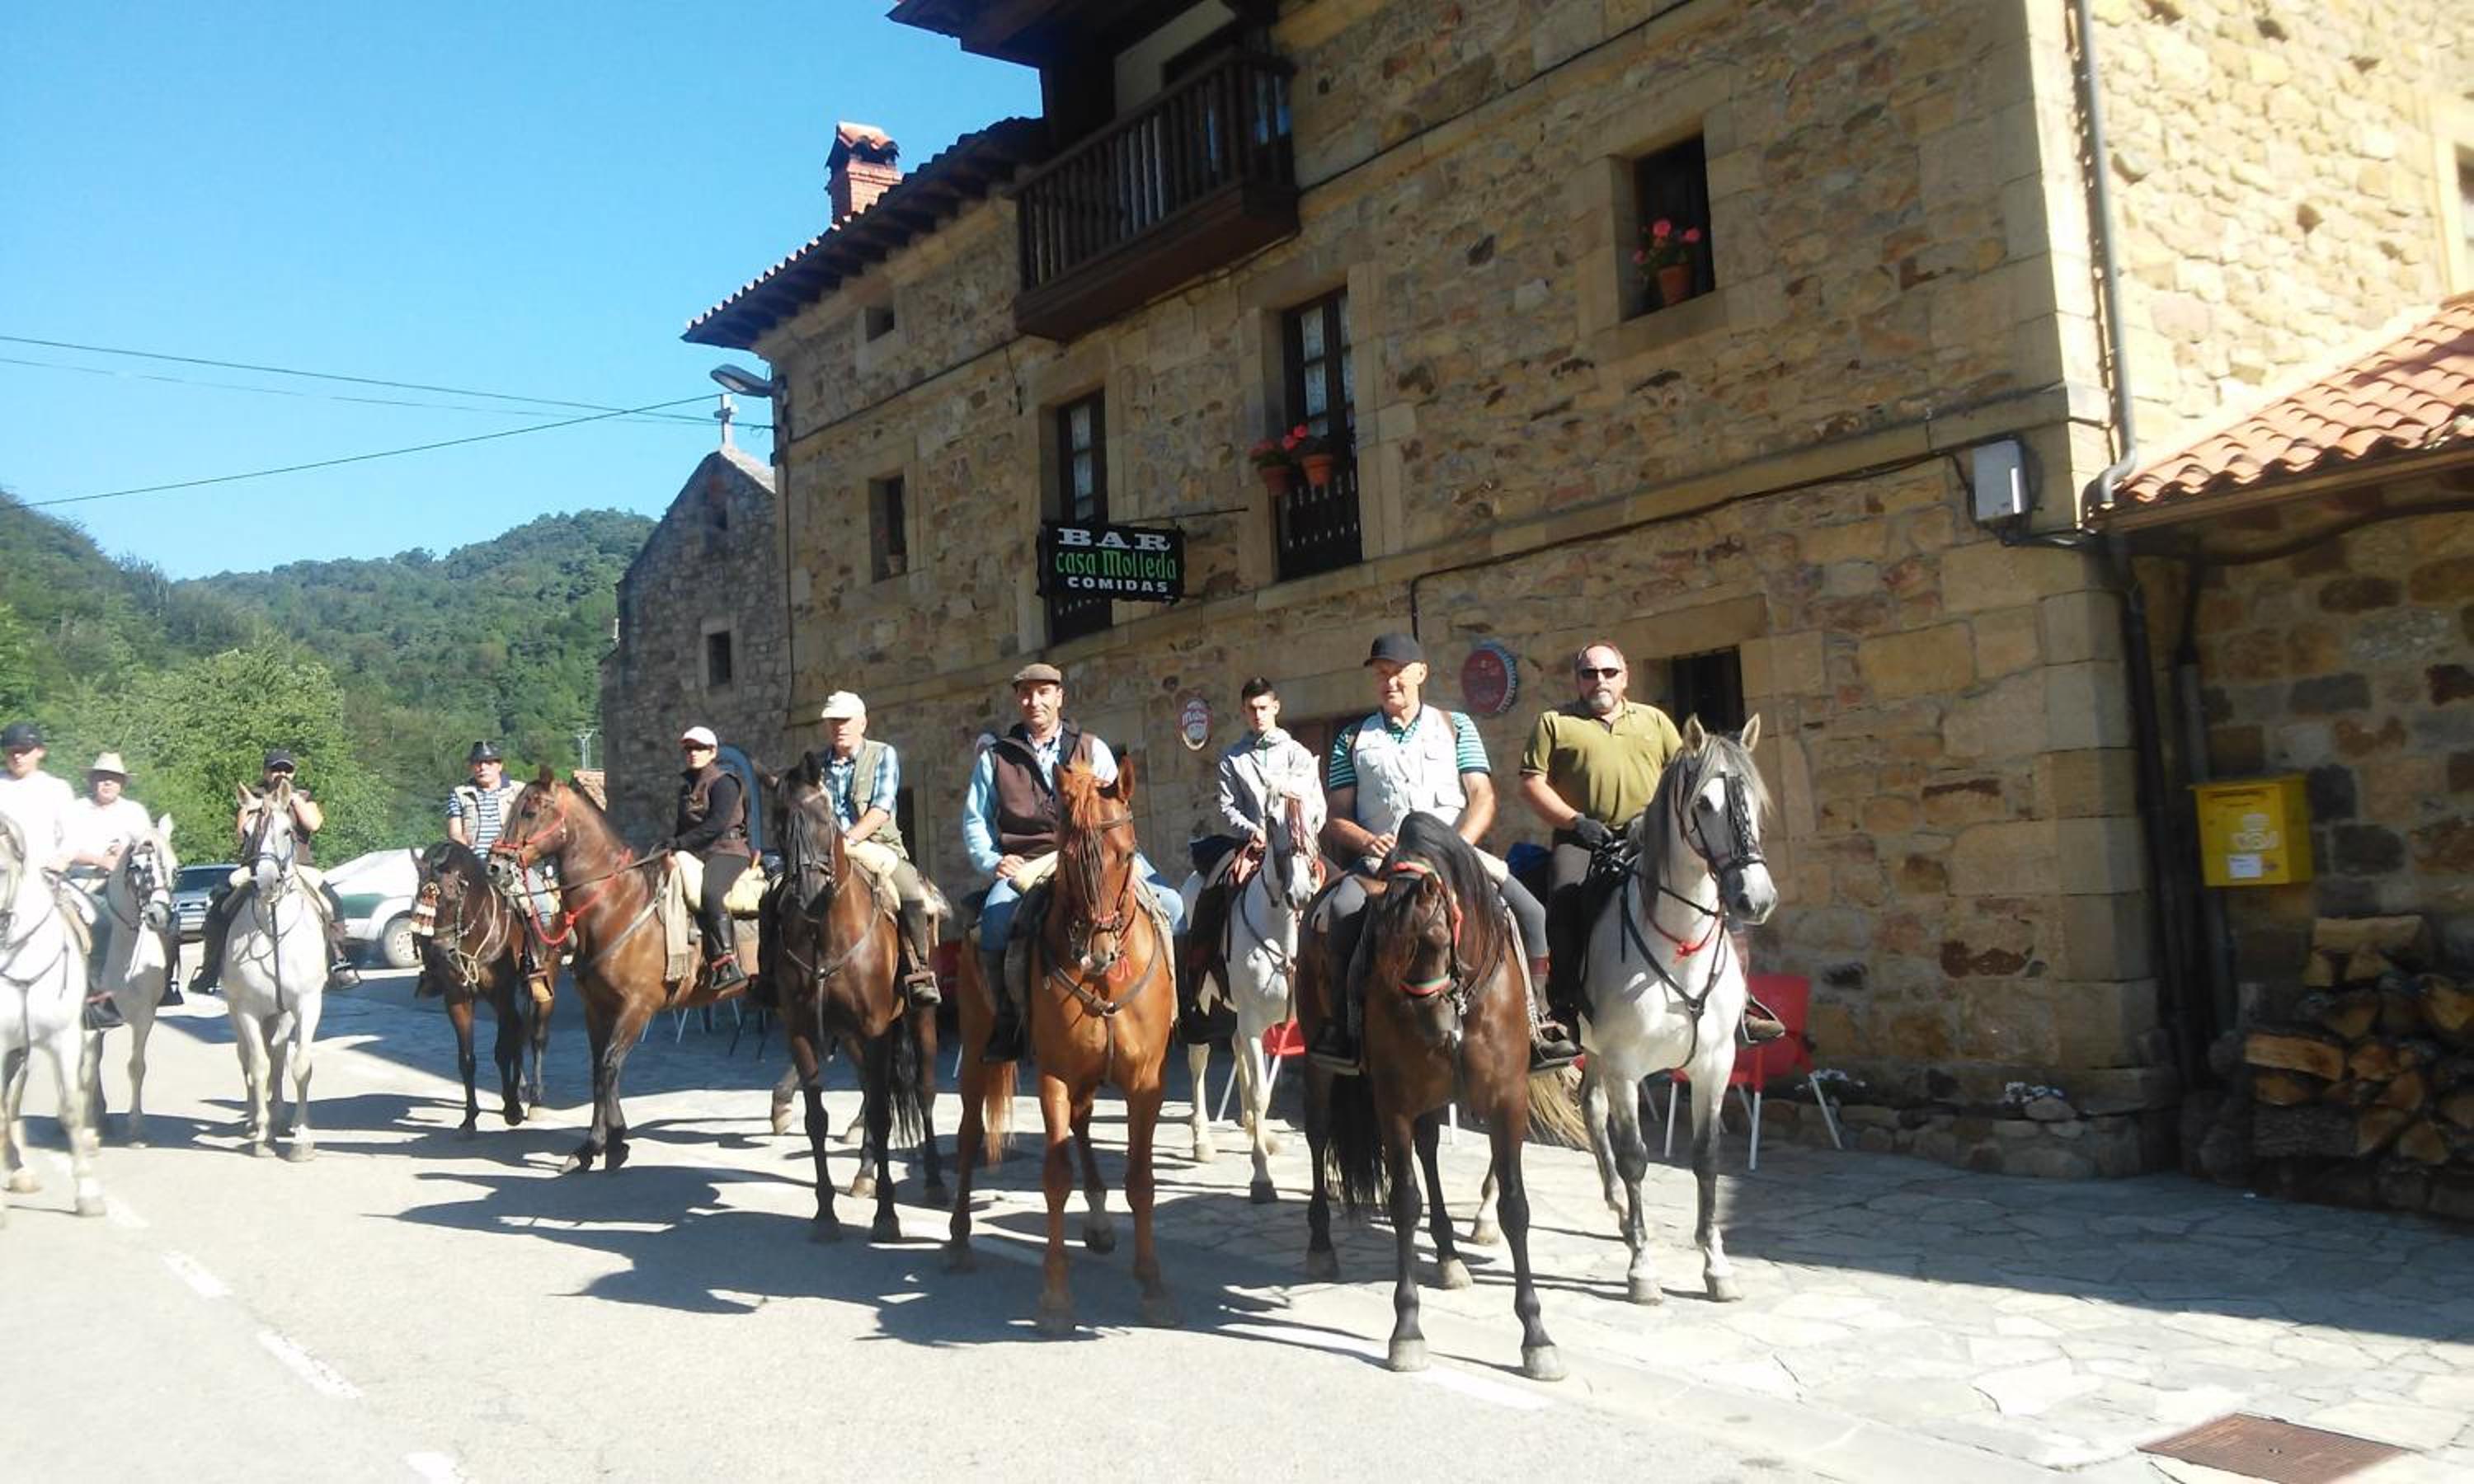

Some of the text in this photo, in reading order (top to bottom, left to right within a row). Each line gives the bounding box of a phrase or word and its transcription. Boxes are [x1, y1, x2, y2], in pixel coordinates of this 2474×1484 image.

[1057, 528, 1171, 551] BAR
[1102, 550, 1177, 580] Molleda
[1067, 576, 1168, 593] COMIDAS
